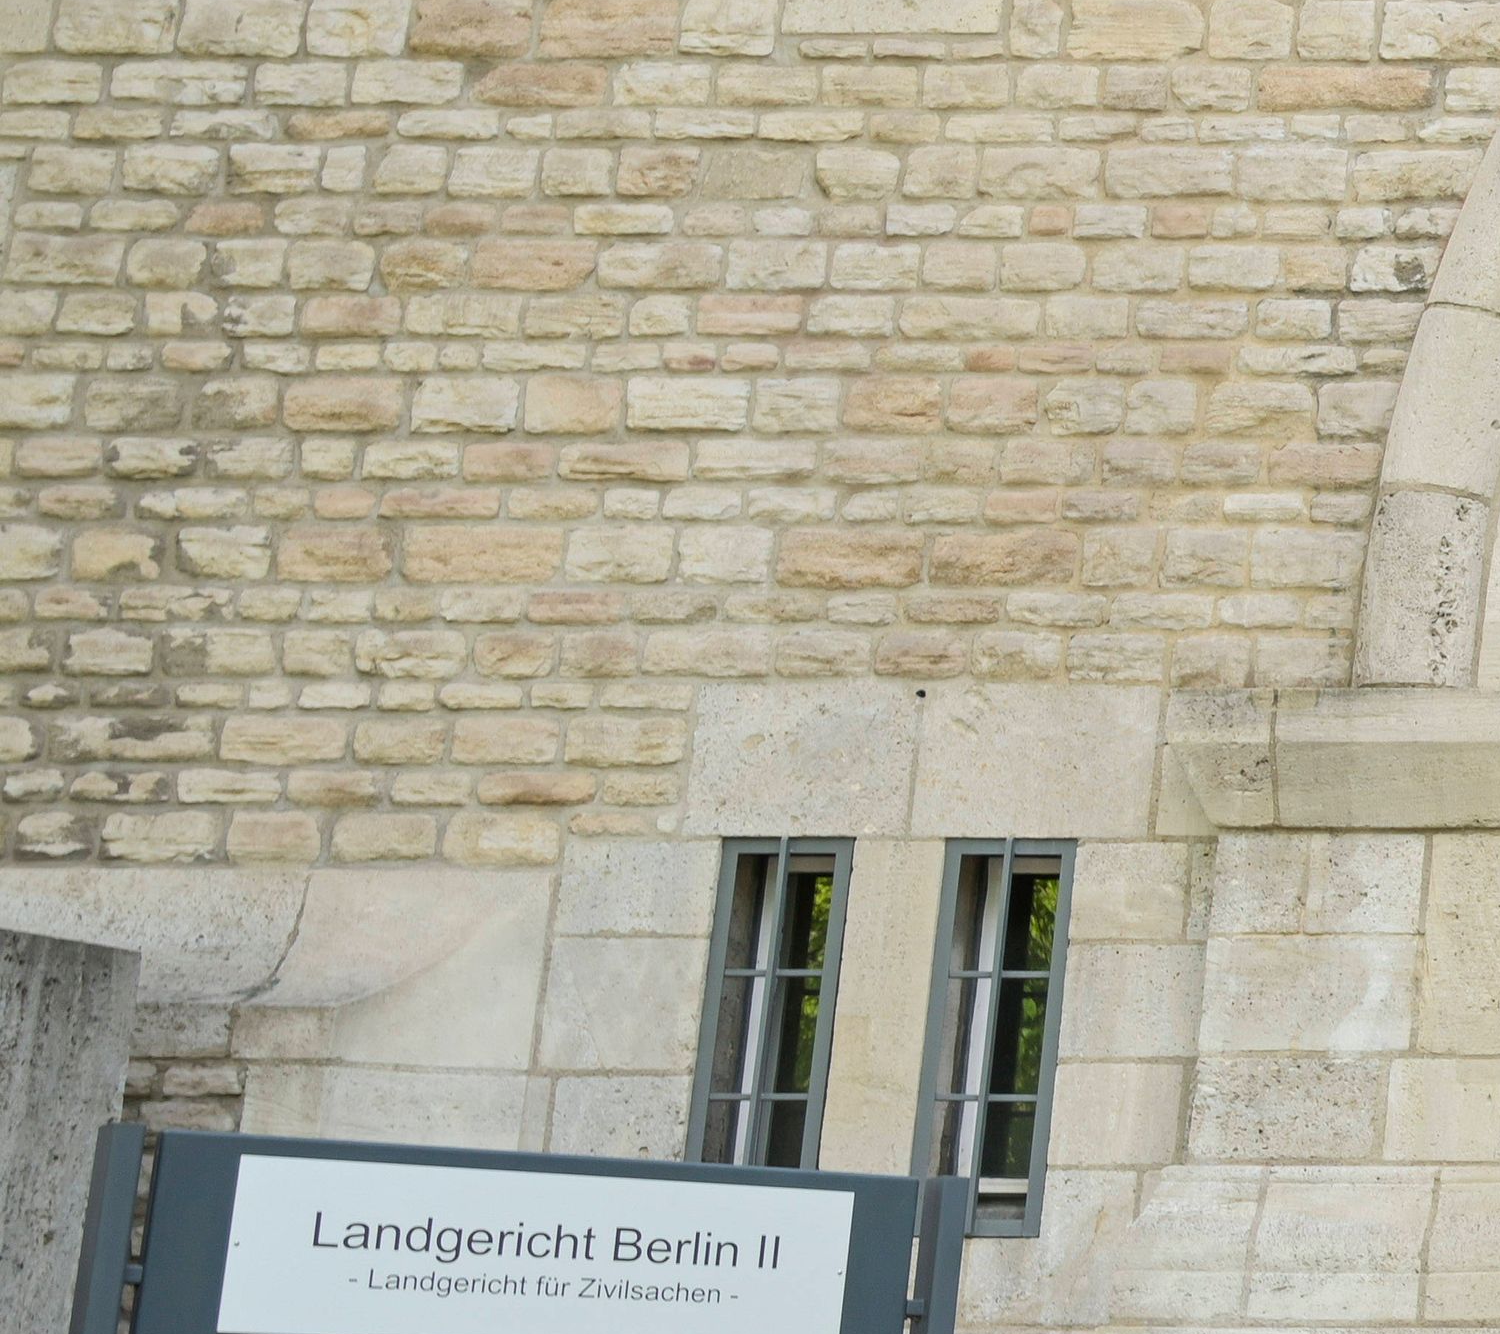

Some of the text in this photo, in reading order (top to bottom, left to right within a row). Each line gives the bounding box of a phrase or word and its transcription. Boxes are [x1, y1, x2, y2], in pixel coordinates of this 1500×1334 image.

[312, 1211, 781, 1269] Landgericht Berlin II
[368, 1269, 528, 1297] Landgericht
[536, 1276, 571, 1298] für
[578, 1278, 721, 1304] Zivilsachen
